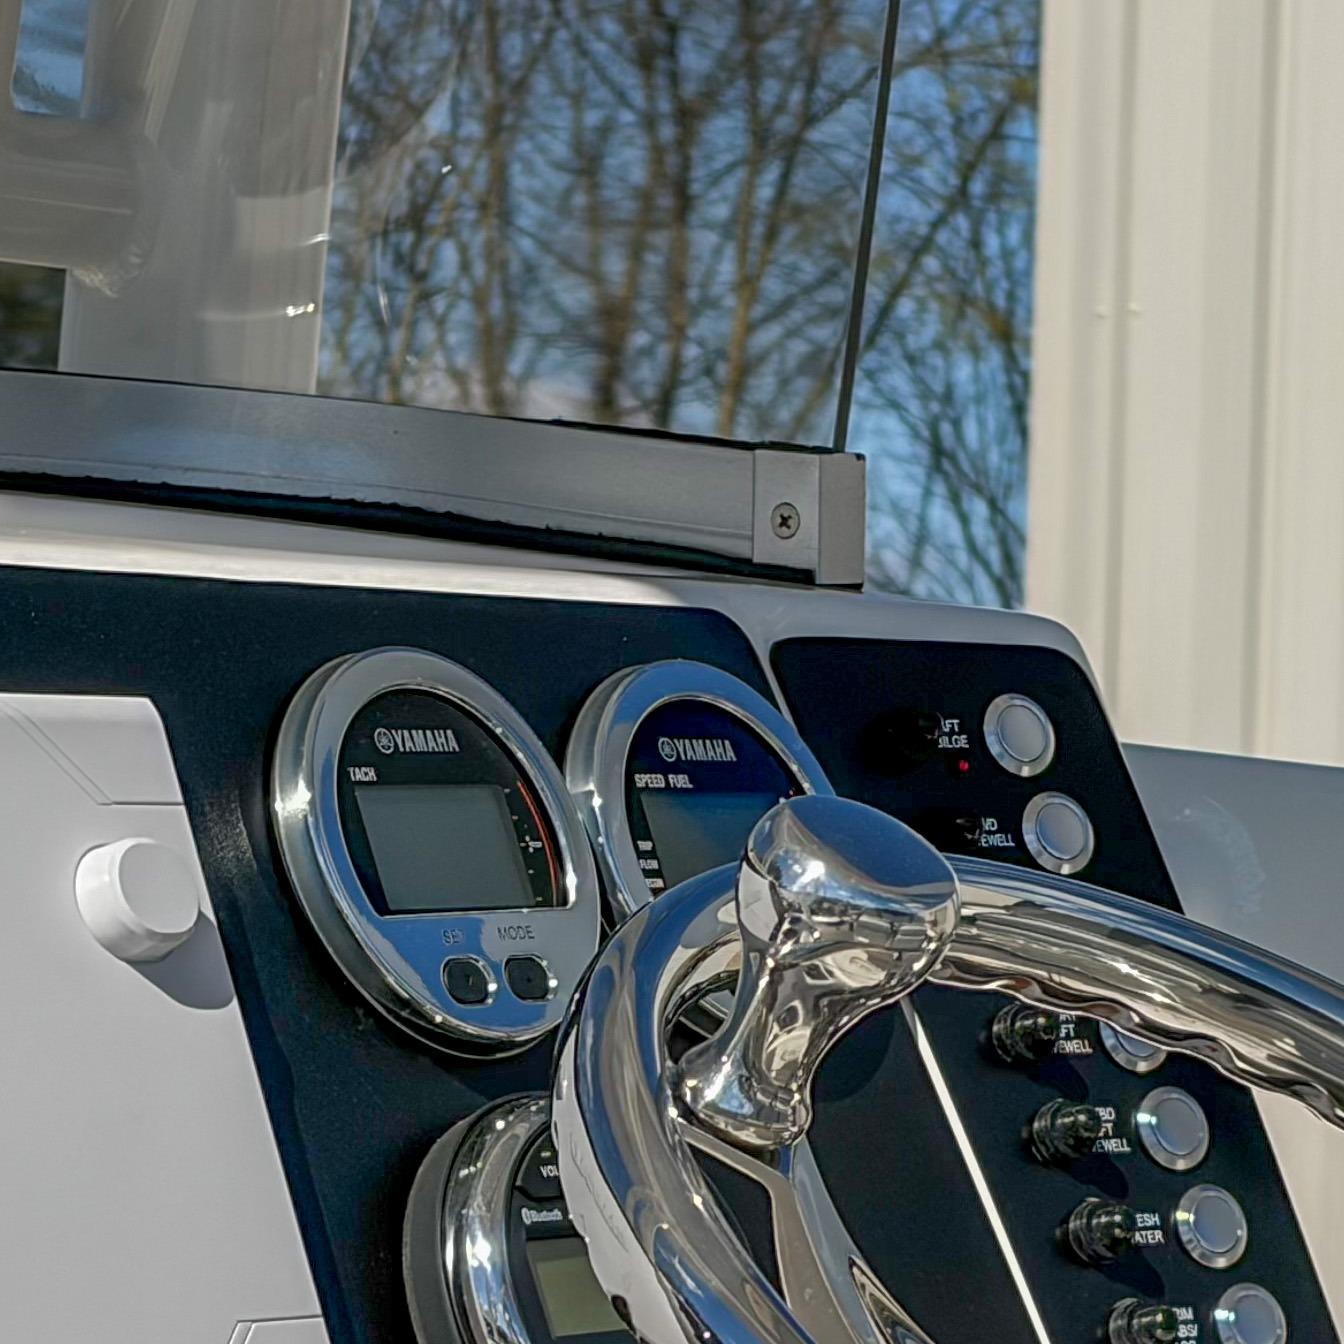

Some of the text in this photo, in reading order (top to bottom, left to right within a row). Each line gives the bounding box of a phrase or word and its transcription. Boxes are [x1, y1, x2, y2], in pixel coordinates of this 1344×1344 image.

[391, 729, 460, 752] YAMAHA
[674, 738, 737, 762] YAMAHA
[347, 766, 377, 782] TACH
[634, 773, 694, 788] SPEED FUEL
[497, 925, 535, 941] MODE
[540, 1165, 559, 1178] VOL
[1132, 1229, 1165, 1244] ATER
